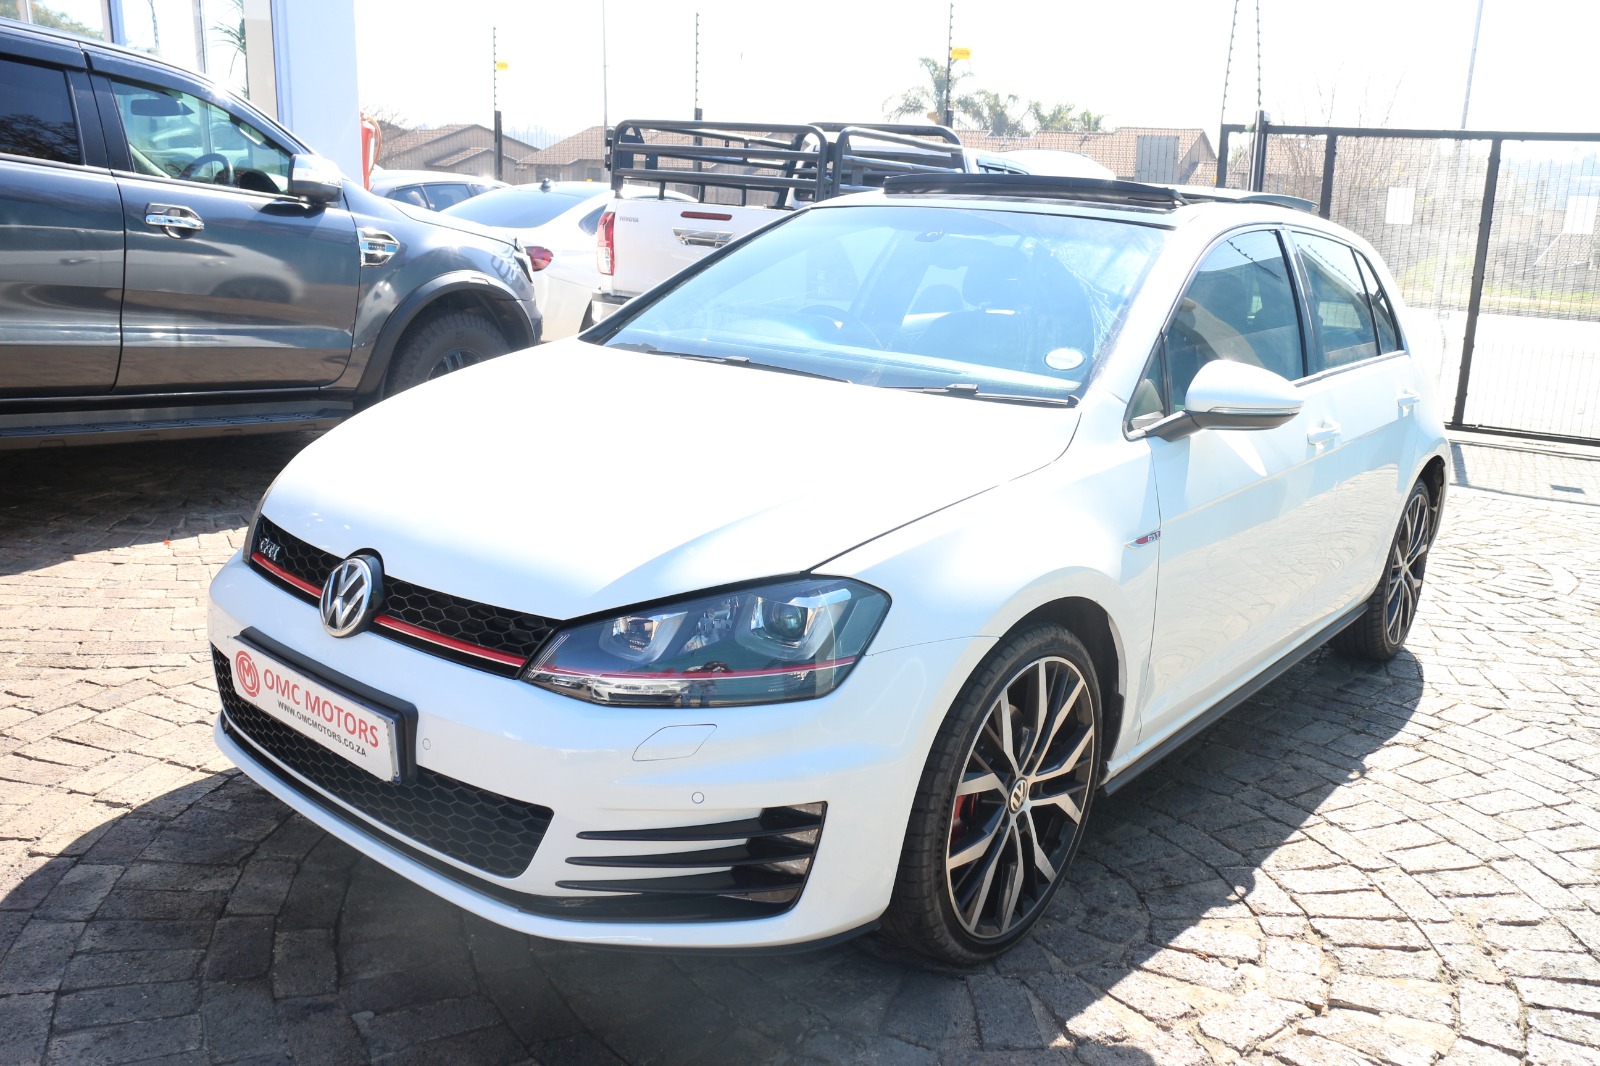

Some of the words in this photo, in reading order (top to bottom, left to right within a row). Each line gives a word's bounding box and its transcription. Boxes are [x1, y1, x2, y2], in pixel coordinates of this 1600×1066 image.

[619, 215, 640, 223] TOYOTA
[263, 669, 301, 705] OMC
[305, 690, 379, 748] MOTORS
[277, 699, 367, 757] WWW.OMCMOTORS.CO.ZA
